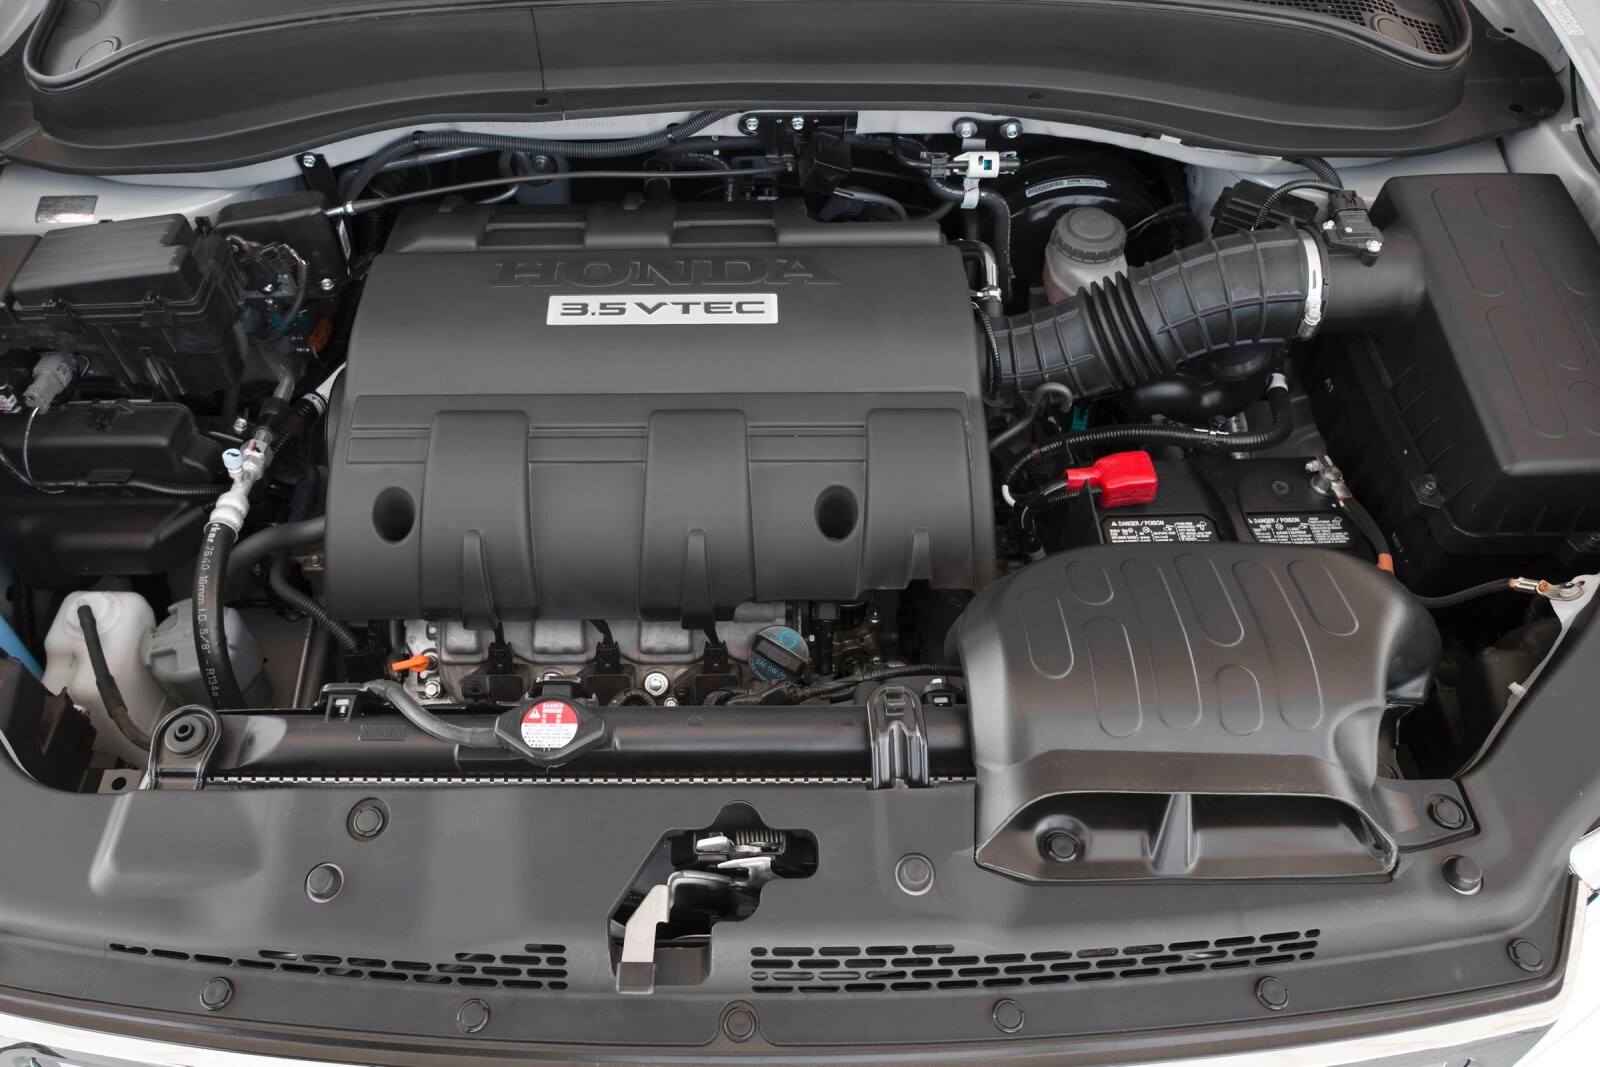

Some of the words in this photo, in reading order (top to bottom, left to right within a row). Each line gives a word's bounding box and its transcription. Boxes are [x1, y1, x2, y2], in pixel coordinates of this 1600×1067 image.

[490, 257, 841, 287] HONDA
[198, 575, 209, 605] 16mm
[755, 658, 767, 669] SAE
[767, 665, 787, 680] 5W-20
